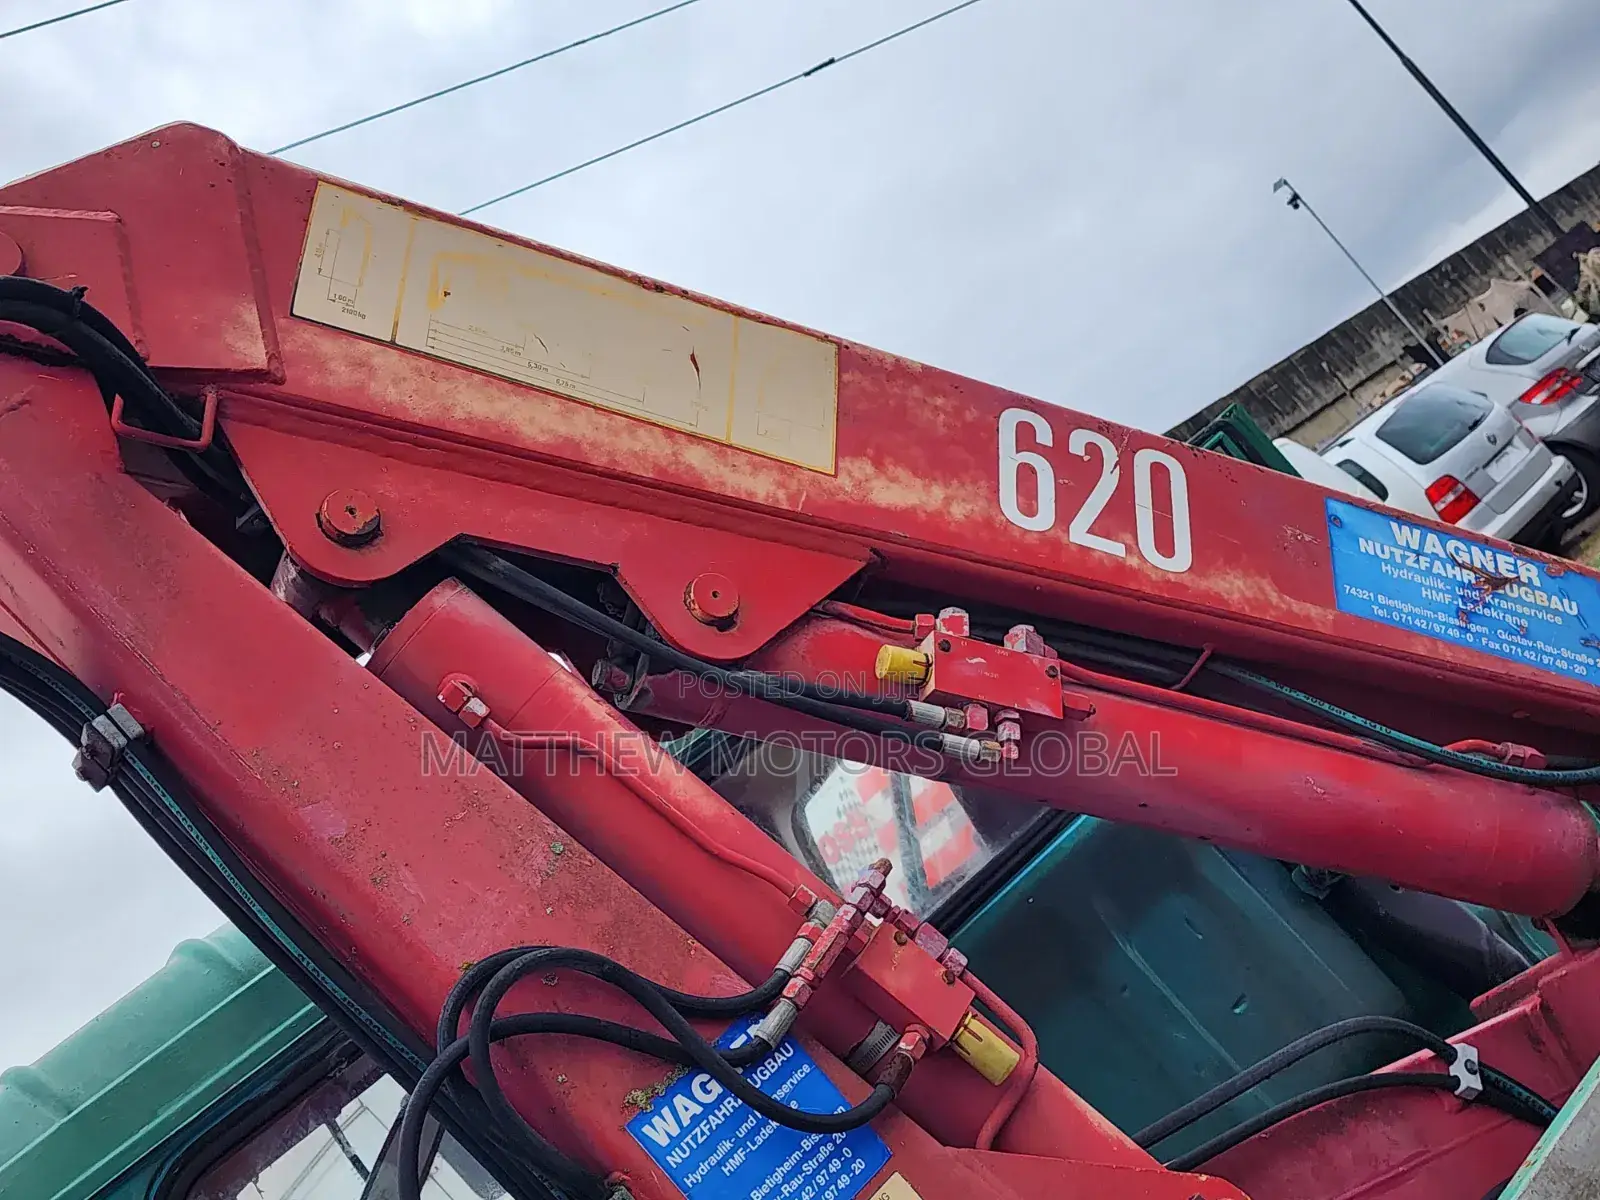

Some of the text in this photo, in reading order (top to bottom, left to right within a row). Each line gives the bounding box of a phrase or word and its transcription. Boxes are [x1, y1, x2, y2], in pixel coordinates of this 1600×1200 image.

[998, 407, 1192, 574] 620
[1390, 520, 1542, 588] WAGNER
[1344, 584, 1375, 602] 74321
[1381, 562, 1563, 626] Hydraulik- und Kranservice
[1421, 588, 1528, 628] HMF-Ladekrane
[1482, 636, 1502, 652] Fax
[683, 1137, 736, 1188] Hydraulik-
[736, 1114, 756, 1138] und
